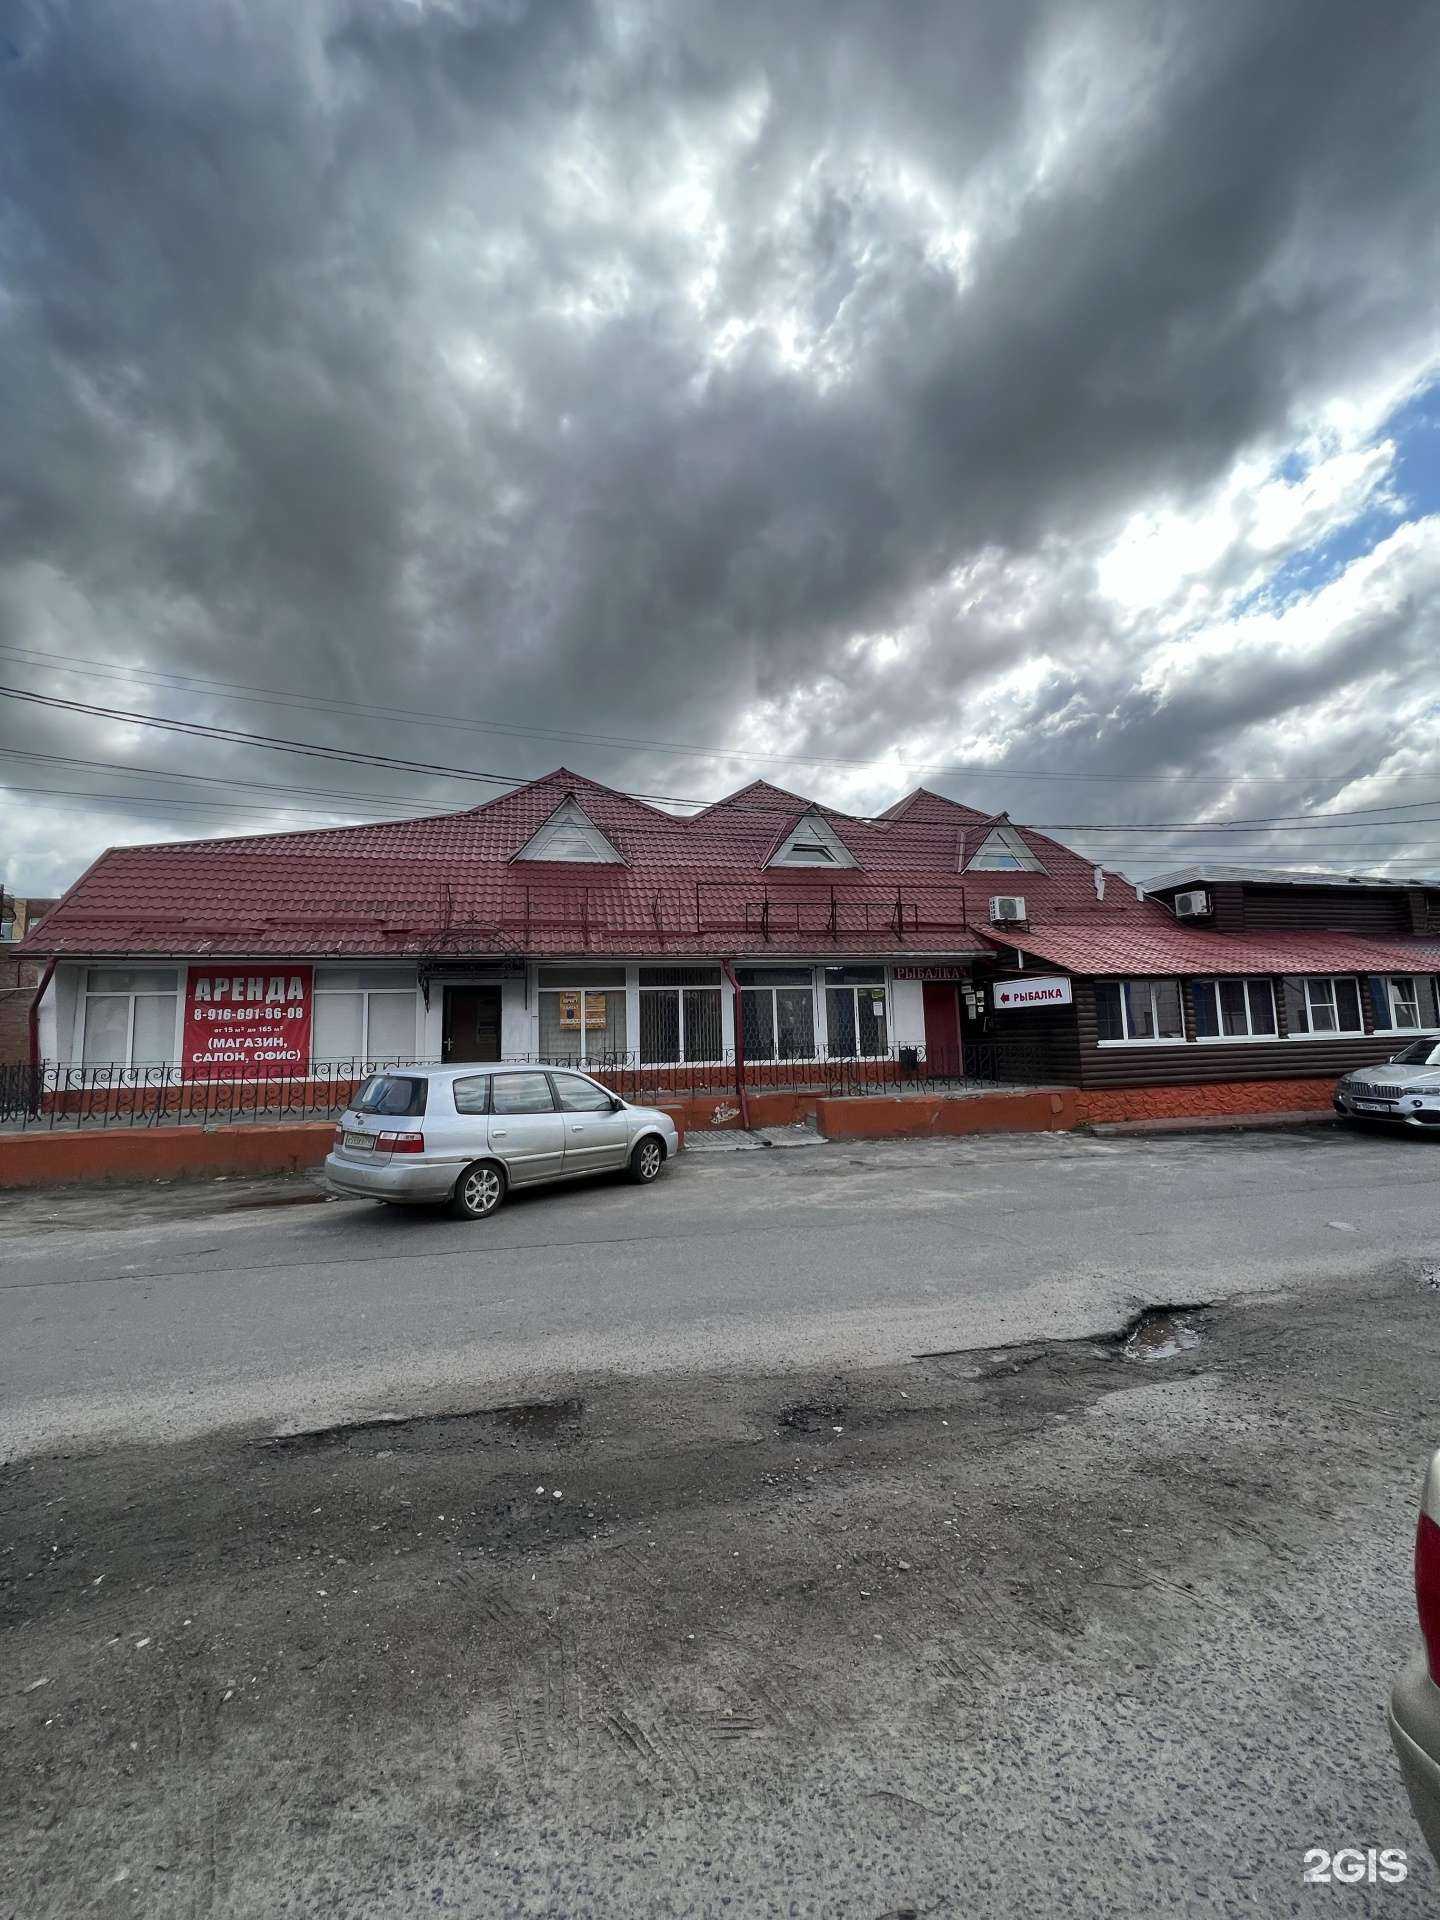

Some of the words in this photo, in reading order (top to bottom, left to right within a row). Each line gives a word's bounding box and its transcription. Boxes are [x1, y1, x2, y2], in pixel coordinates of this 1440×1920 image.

[194, 976, 304, 1004] АРЕНДА
[1013, 988, 1063, 1002] РЫБАЛКА
[208, 1037, 288, 1049] (МАГАЗИН,
[192, 1052, 249, 1063] САЛОН,
[253, 1049, 301, 1061] ОФИС)
